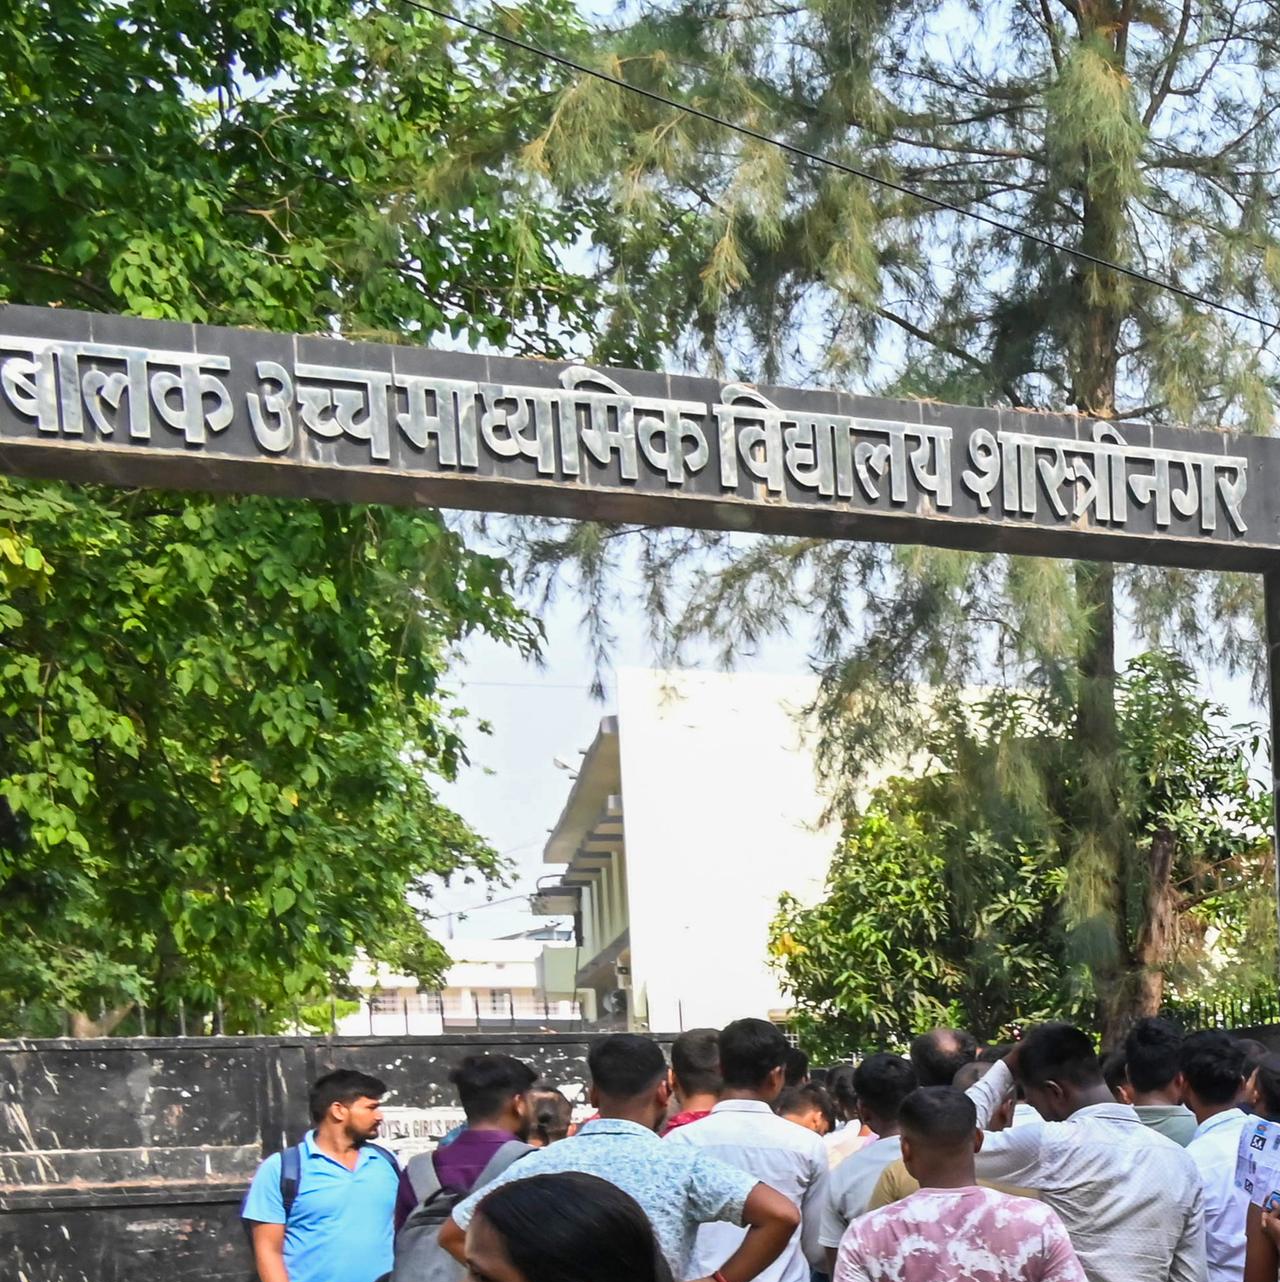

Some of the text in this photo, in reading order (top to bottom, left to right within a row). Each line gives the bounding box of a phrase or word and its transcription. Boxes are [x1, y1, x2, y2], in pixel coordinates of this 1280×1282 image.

[0, 335, 234, 444] बालक
[712, 384, 953, 507] विद्यालय
[962, 421, 1248, 533] शास्त्रीनगर
